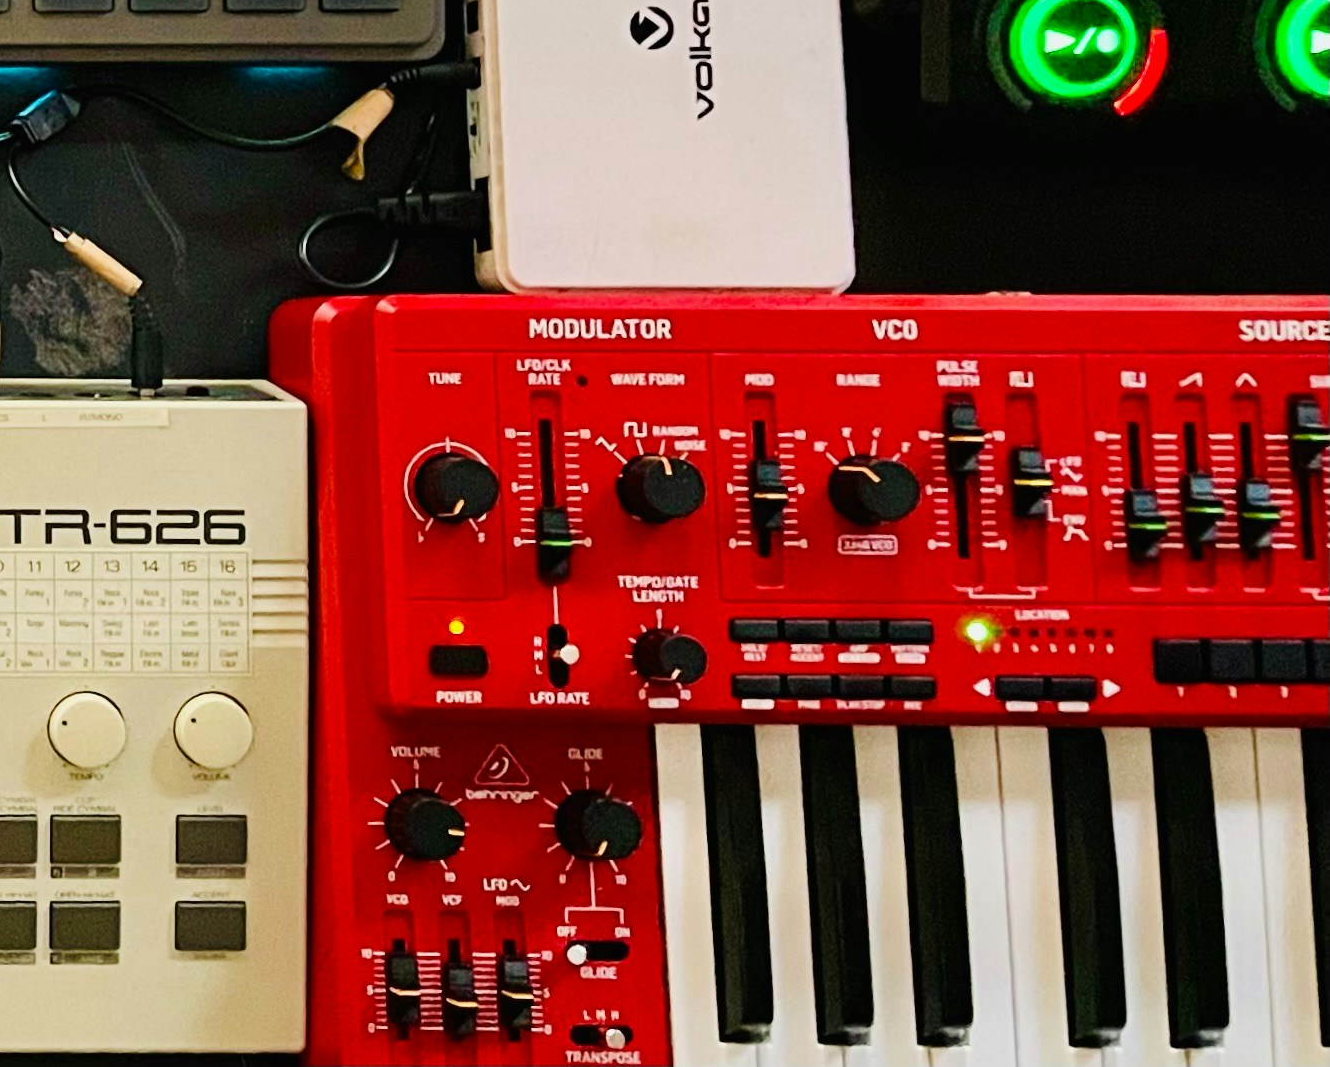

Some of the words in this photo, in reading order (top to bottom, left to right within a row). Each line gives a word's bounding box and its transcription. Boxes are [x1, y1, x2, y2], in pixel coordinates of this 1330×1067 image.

[528, 318, 673, 340] MODULATOR
[871, 319, 919, 340] VCO
[1239, 319, 1330, 340] SOURCE
[515, 358, 572, 372] LFO/CLK
[428, 371, 462, 386] TUNE
[527, 372, 562, 387] RATE
[610, 372, 646, 387] WAVE
[648, 372, 686, 387] FORM
[744, 373, 776, 387] MOD
[836, 373, 882, 388] RANGE
[937, 374, 981, 388] WIDTH
[652, 424, 699, 437] RANDOM
[673, 439, 708, 452] NOISE
[28, 559, 42, 574] 11
[64, 559, 82, 574] 12
[103, 559, 121, 574] 13
[142, 559, 159, 574] 14
[180, 559, 198, 574] 15
[219, 559, 237, 574] 16
[617, 575, 699, 590] TEMPO/GATE
[632, 590, 684, 604] LENGTH
[1014, 608, 1071, 621] LOCATION
[436, 690, 483, 705] POWER
[529, 692, 556, 706] LFO
[557, 692, 591, 706] RATE
[390, 746, 441, 759] VOLUME
[567, 747, 604, 761] GLIDE
[465, 788, 540, 804] behringer
[482, 878, 508, 892] LFO
[580, 967, 618, 980] GLIDE
[564, 1050, 642, 1065] TRANSPOSE
